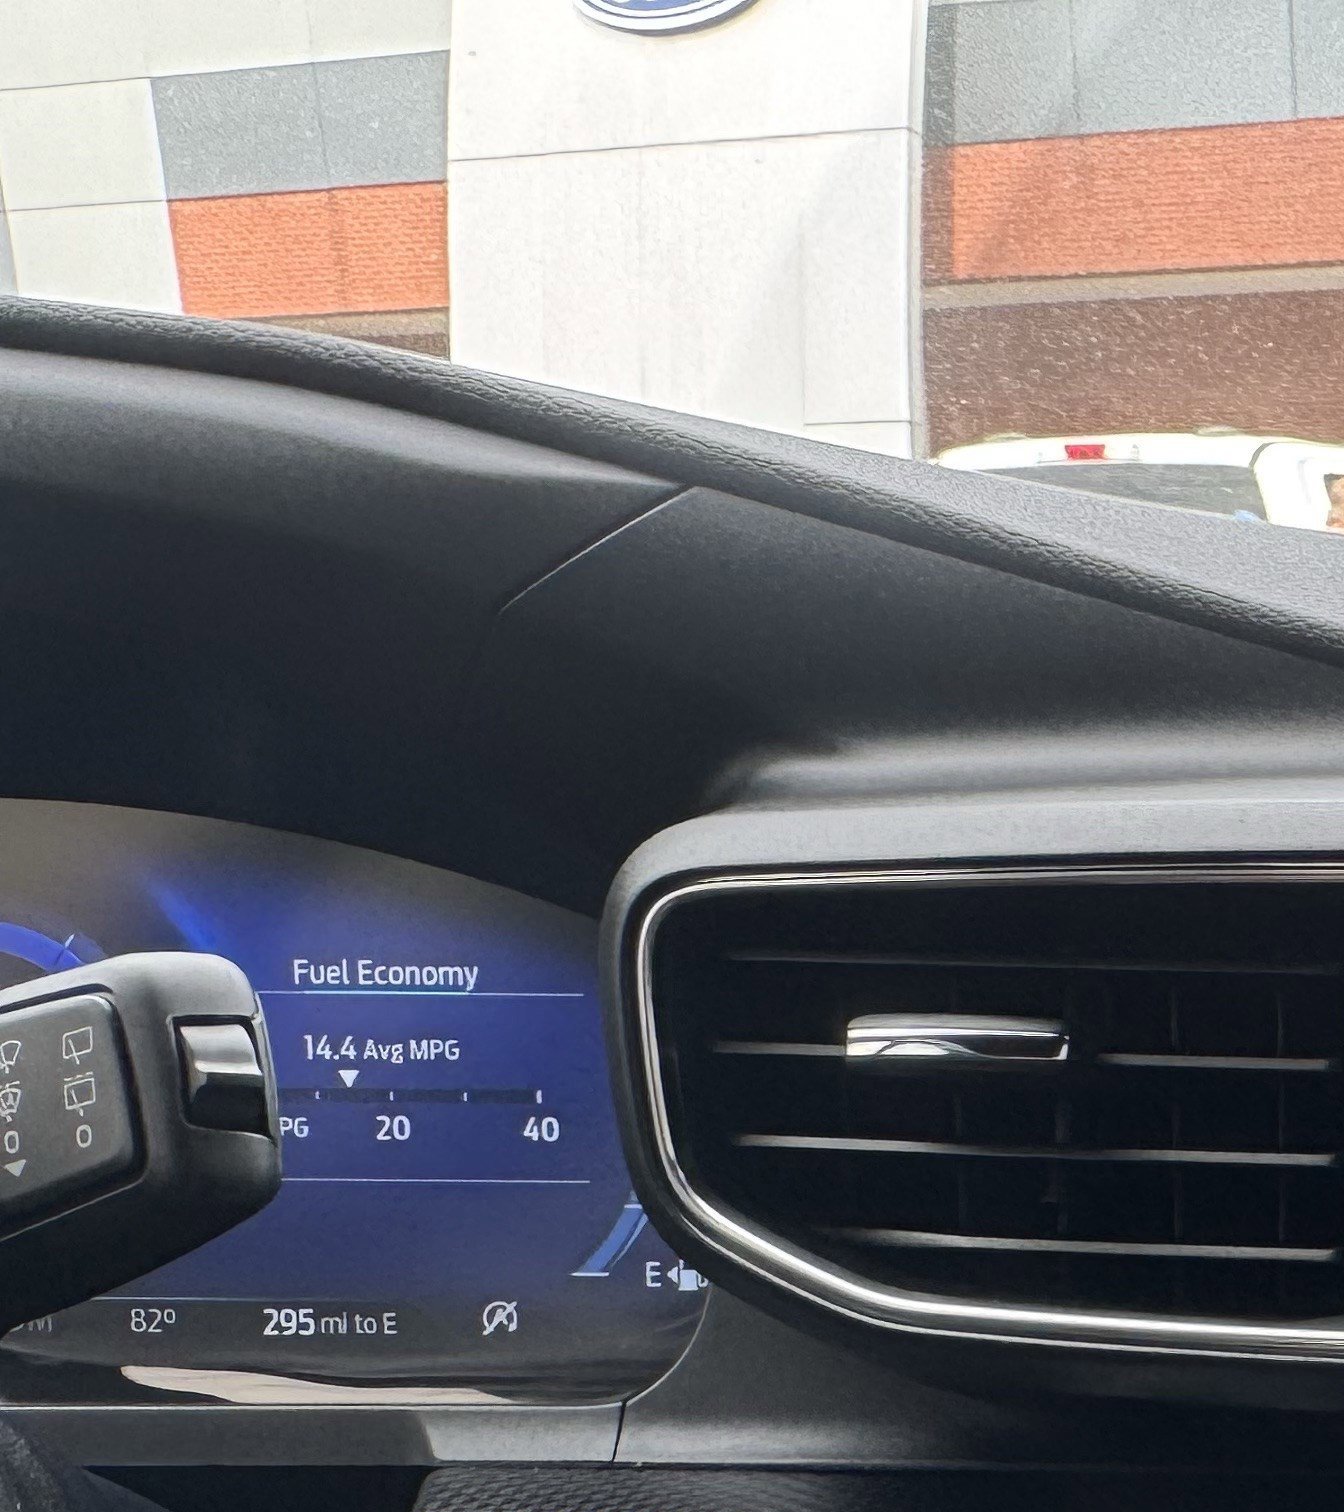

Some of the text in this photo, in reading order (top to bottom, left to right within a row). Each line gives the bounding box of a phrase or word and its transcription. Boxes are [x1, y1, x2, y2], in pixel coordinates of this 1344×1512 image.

[293, 959, 479, 991] Fuel Economy
[303, 1034, 460, 1064] 14.4 Avg MPG
[279, 1117, 309, 1138] PG
[376, 1115, 411, 1141] 20
[523, 1116, 560, 1142] 40
[645, 1262, 660, 1286] E
[130, 1308, 176, 1333] 82°
[262, 1308, 398, 1336] 295 mi to E
